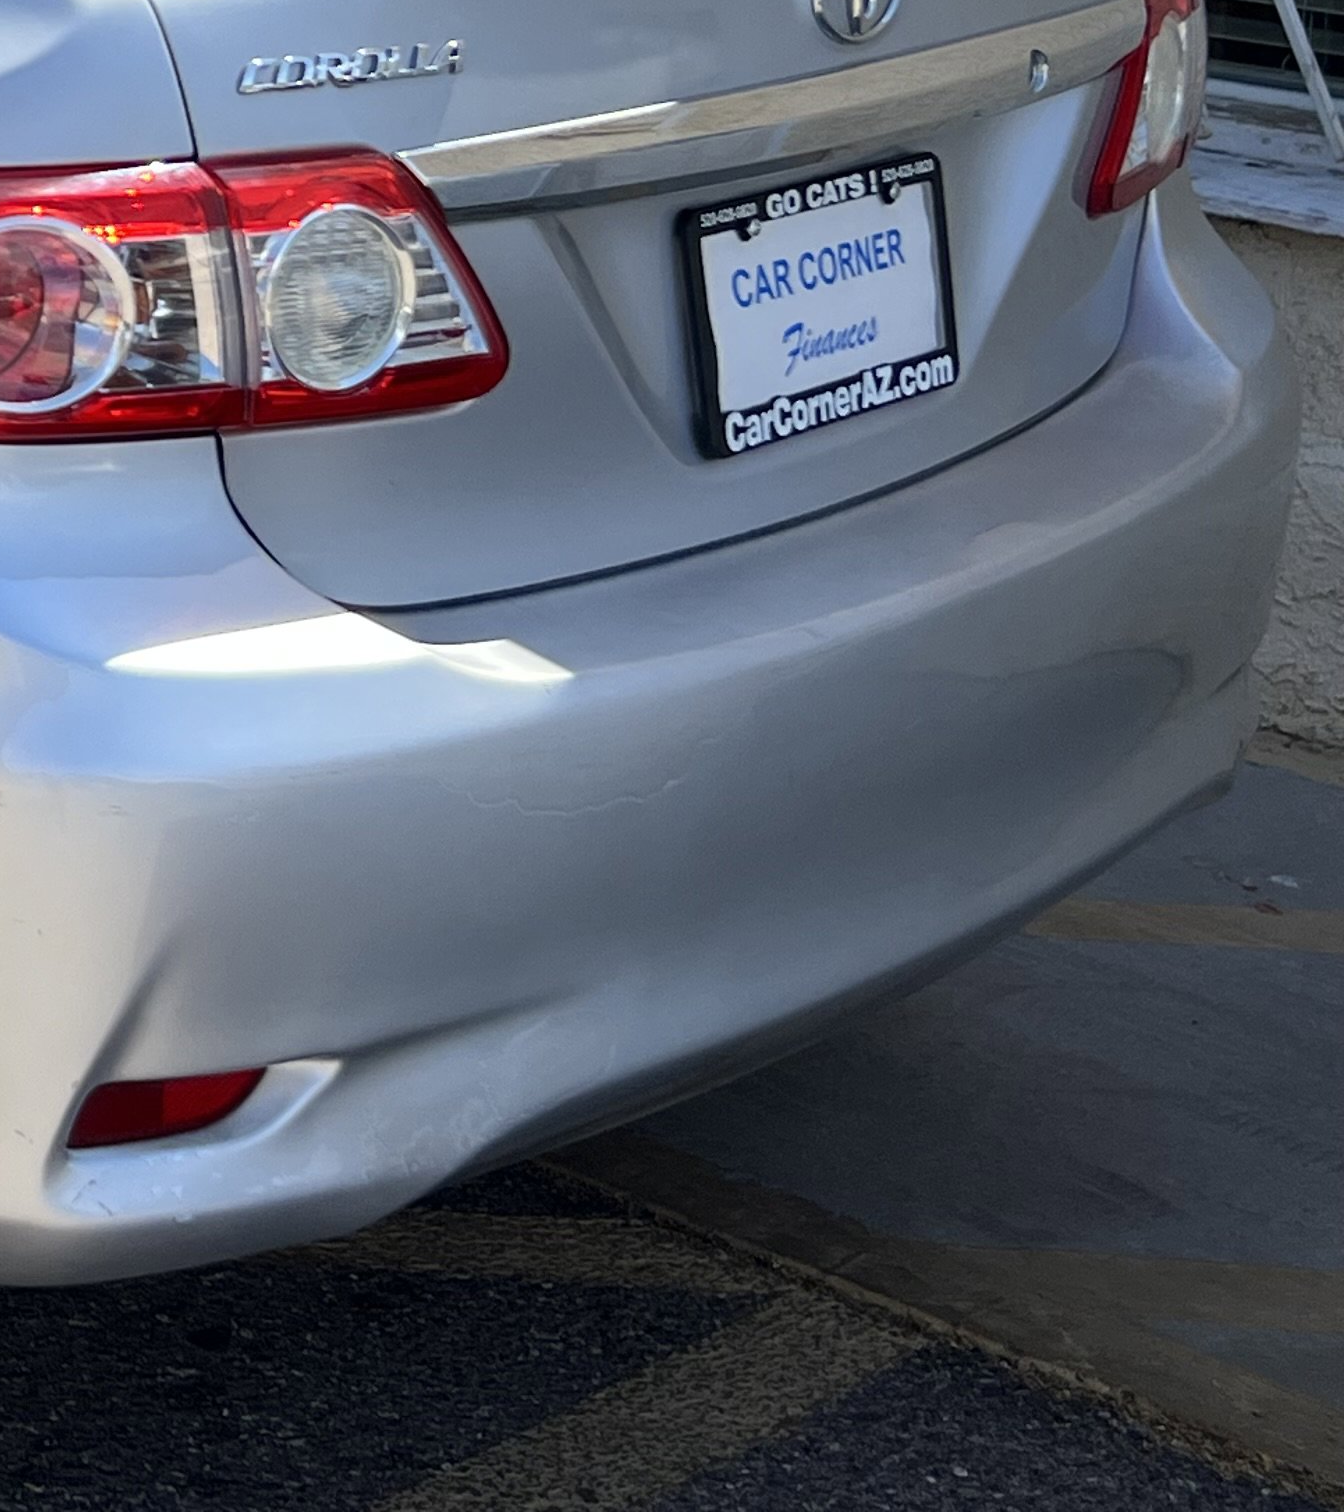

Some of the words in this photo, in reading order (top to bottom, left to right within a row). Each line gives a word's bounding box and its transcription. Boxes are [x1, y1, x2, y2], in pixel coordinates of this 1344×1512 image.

[237, 38, 464, 94] COROLLA
[766, 189, 802, 218] GO
[806, 172, 866, 208] CATS
[731, 259, 794, 308] CAR
[798, 228, 906, 290] CORNER
[725, 354, 954, 453] CarCornerAZ.com
